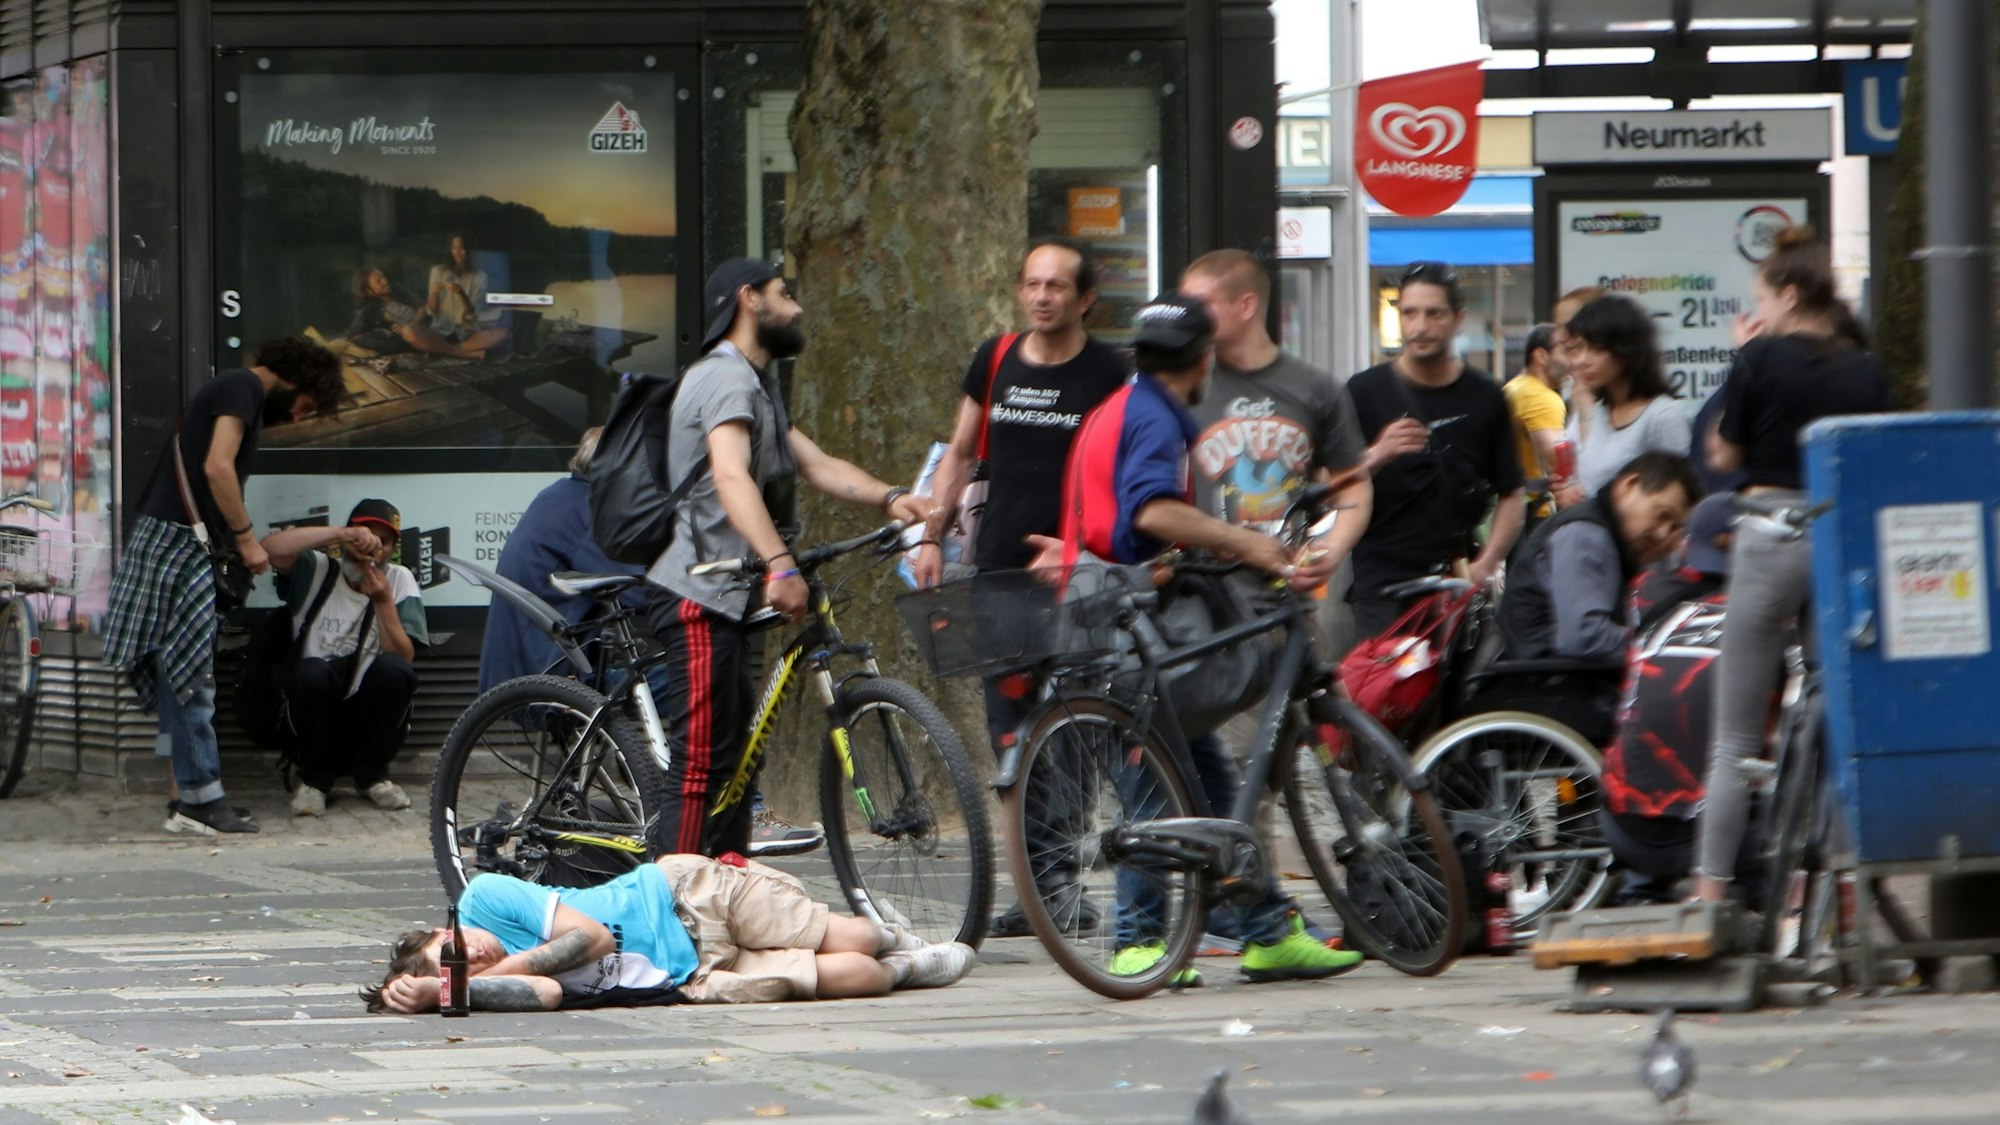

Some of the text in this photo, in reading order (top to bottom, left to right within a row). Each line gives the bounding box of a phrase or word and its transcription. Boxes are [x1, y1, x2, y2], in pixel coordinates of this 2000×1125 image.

[1862, 77, 1908, 141] U
[266, 116, 436, 154] Making Moments
[591, 132, 644, 150] GIZEH
[1605, 119, 1766, 149] Neumarkt
[382, 146, 409, 154] SINCE
[1367, 158, 1464, 181] LANGNESE
[223, 289, 241, 318] S
[1681, 297, 1717, 328] 21.
[992, 403, 1082, 426] #AWESOME
[1229, 396, 1276, 418] Get
[420, 536, 433, 586] GIZEH
